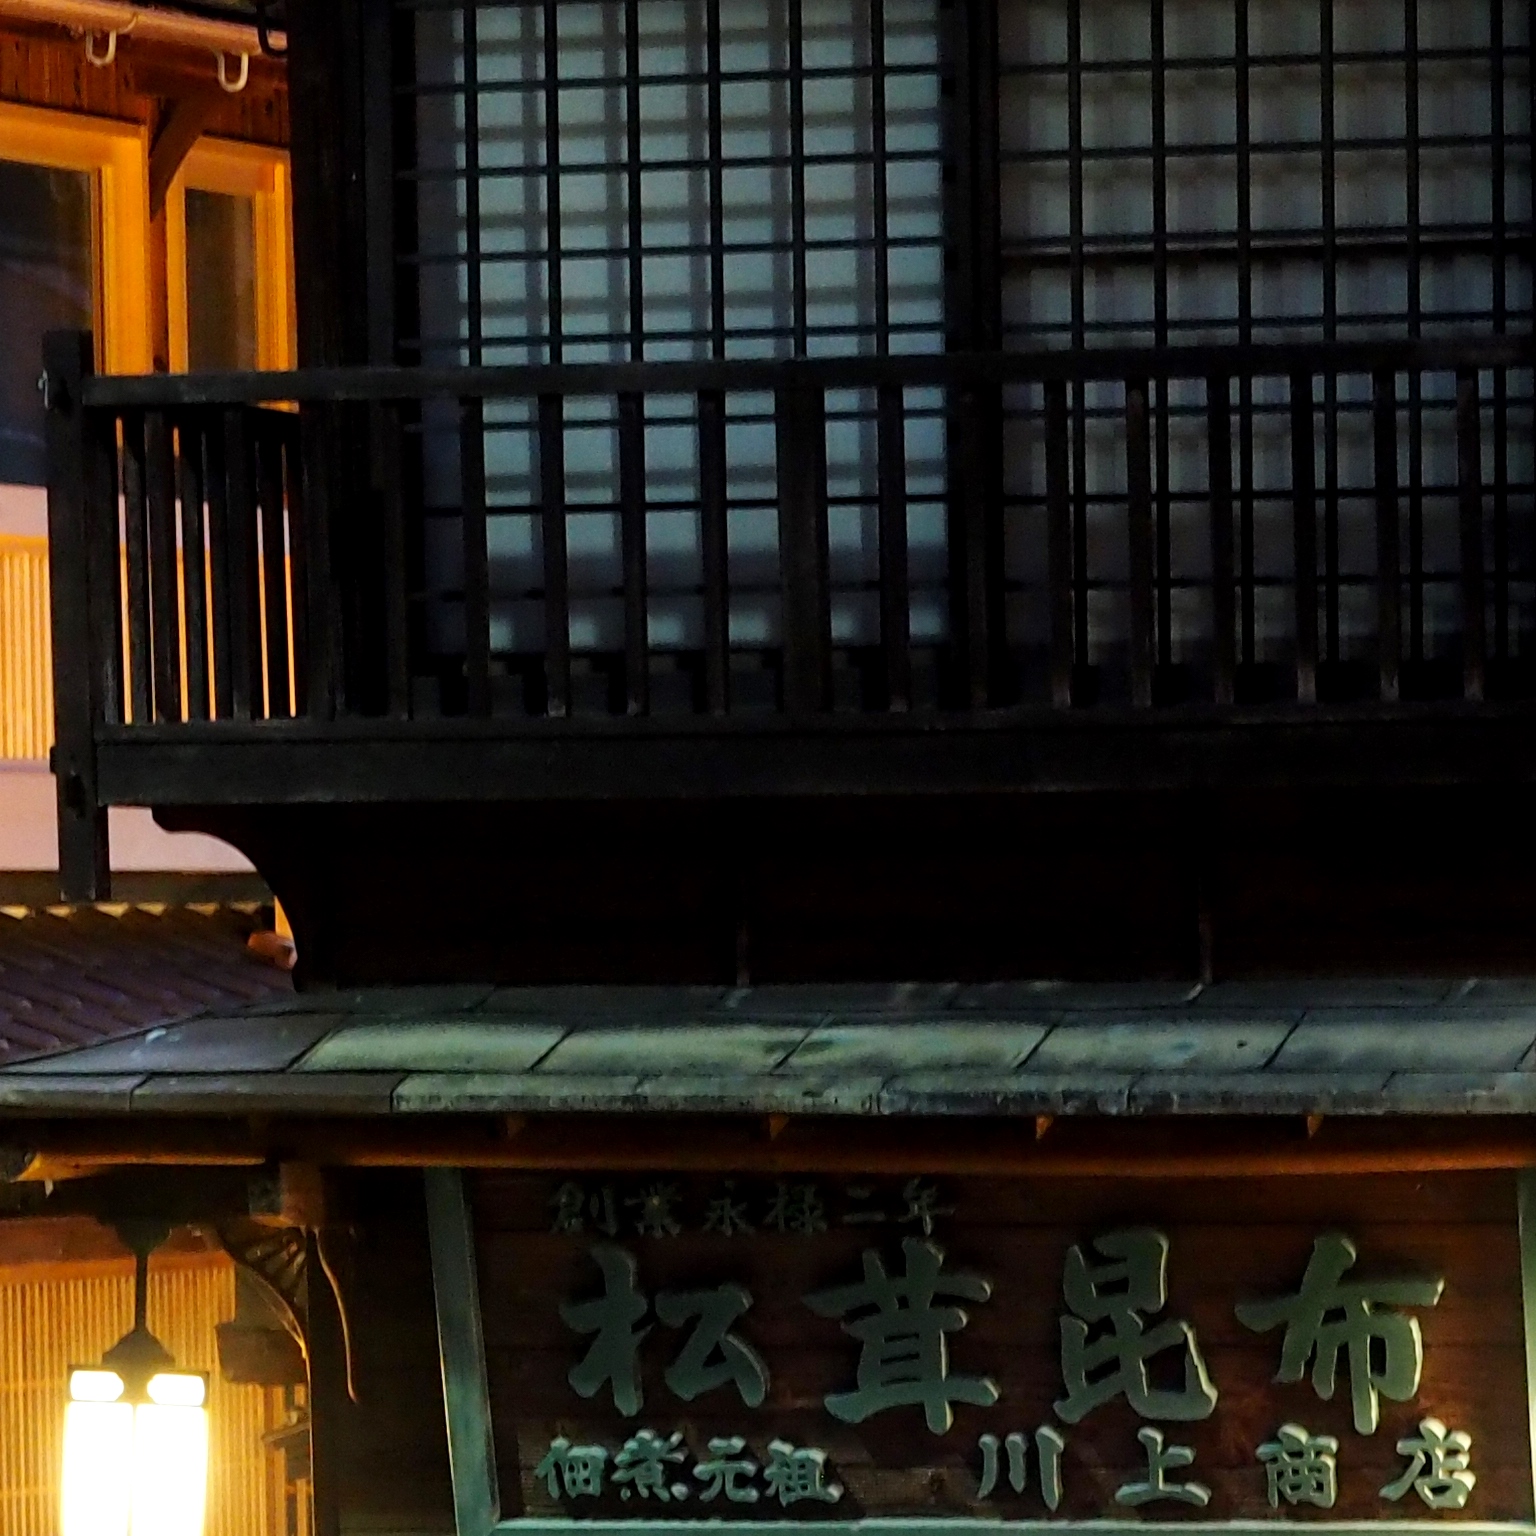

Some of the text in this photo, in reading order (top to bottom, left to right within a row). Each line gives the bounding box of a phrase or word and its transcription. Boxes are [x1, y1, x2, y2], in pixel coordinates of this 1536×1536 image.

[556, 1228, 1445, 1436] 松茸昆布
[534, 1428, 844, 1508] 佃煮元祖
[975, 1416, 1477, 1511] 川上商店
